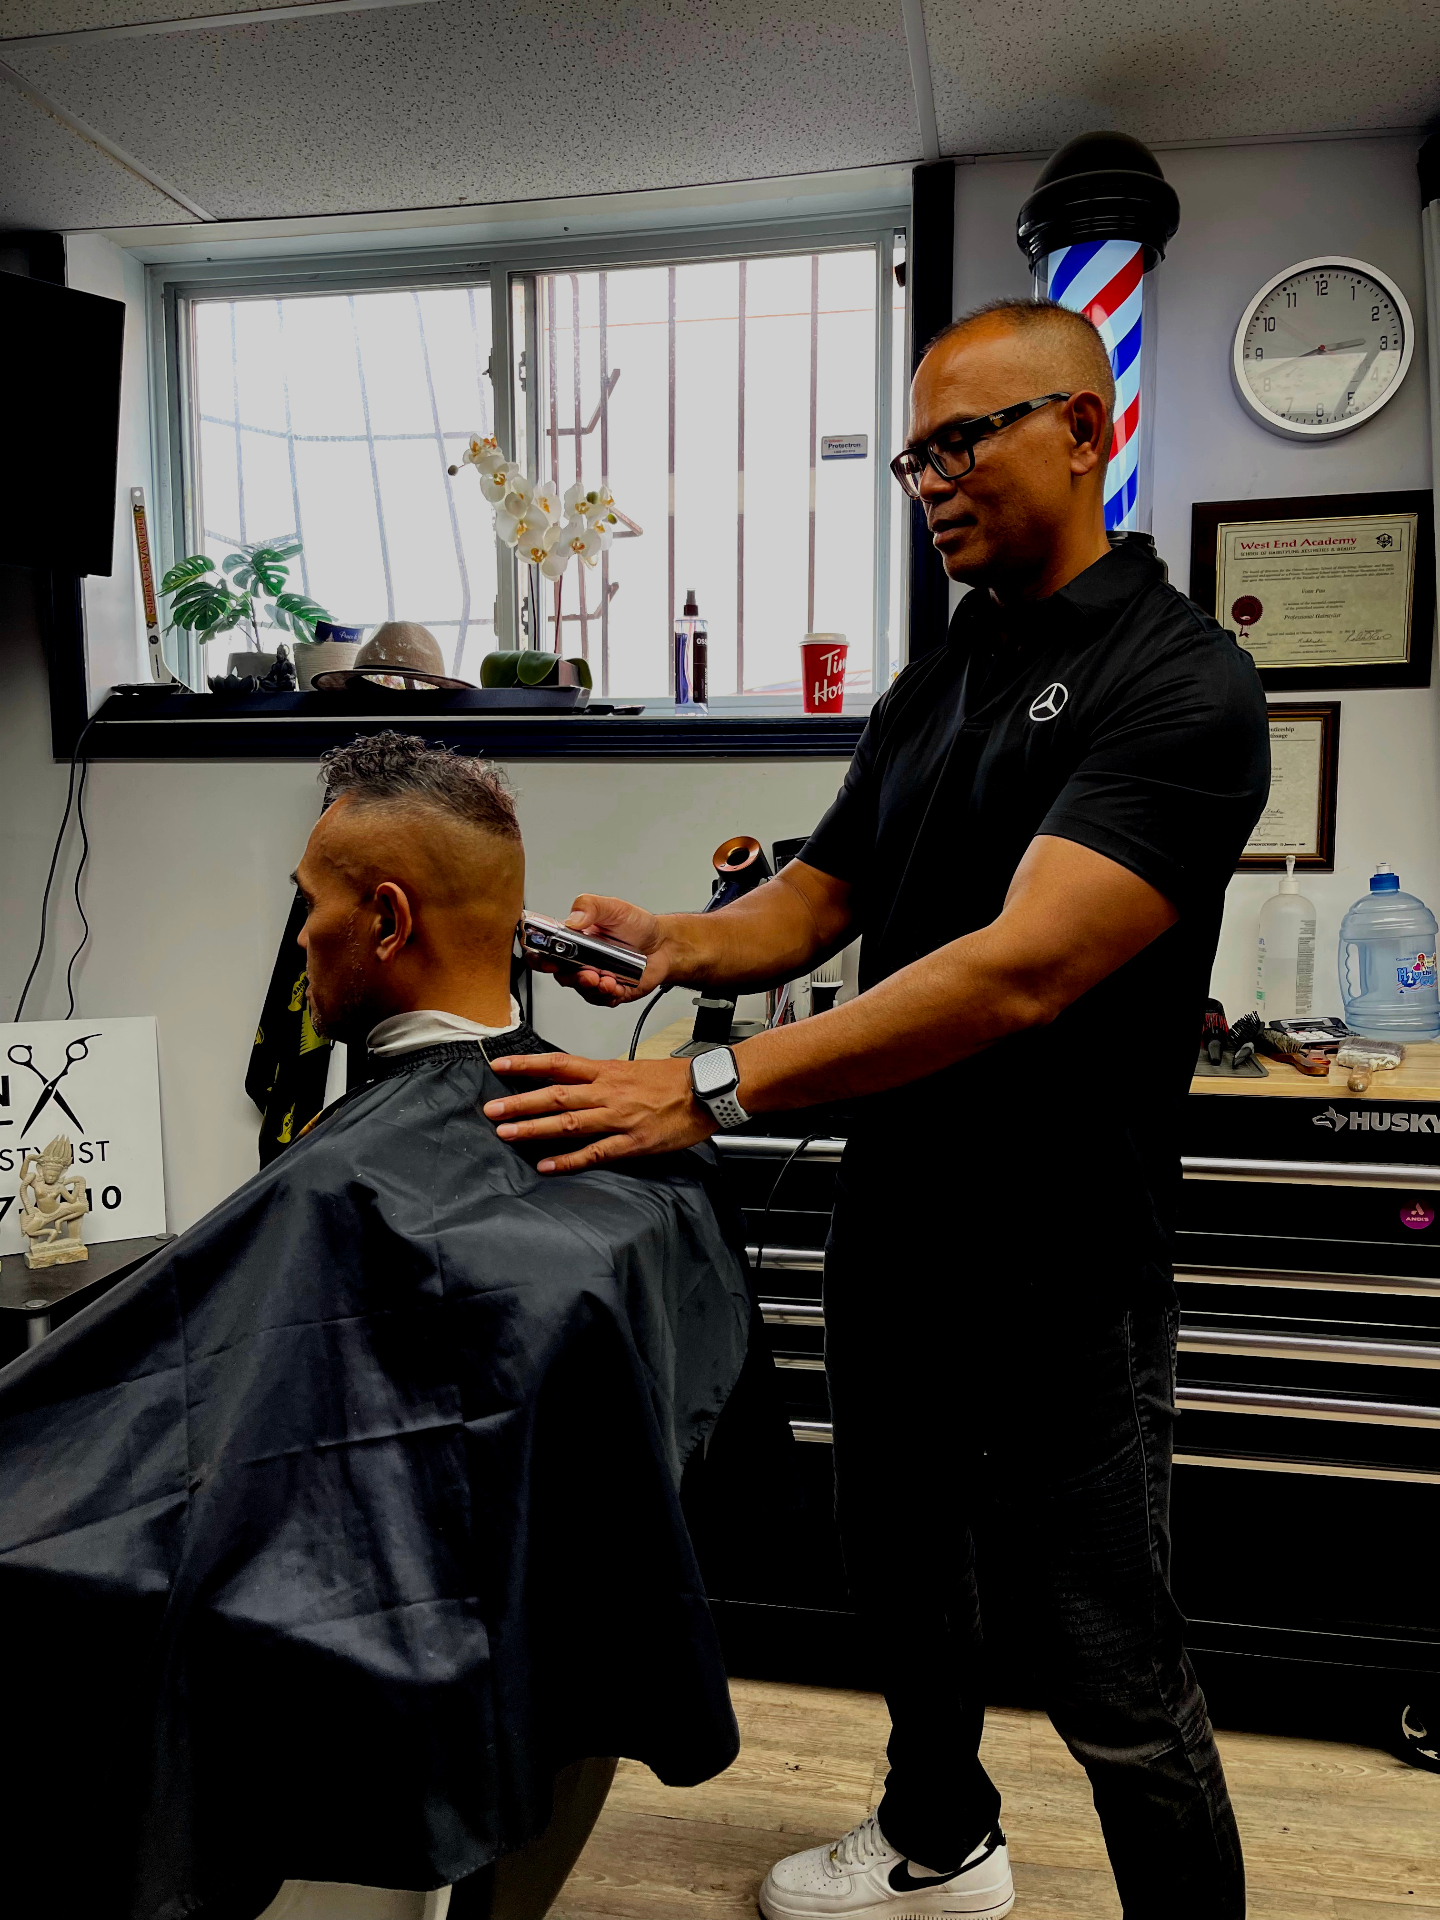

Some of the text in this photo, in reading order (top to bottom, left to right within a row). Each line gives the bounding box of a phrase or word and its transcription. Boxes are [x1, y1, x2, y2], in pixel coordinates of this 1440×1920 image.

[1316, 280, 1328, 296] 12
[1351, 286, 1355, 301] 1
[1286, 293, 1297, 308] 11
[1371, 306, 1380, 322] 2
[1263, 316, 1276, 332] 10
[1380, 336, 1388, 351] 3
[1255, 347, 1263, 362] 9
[1371, 367, 1379, 382] 4
[1263, 377, 1271, 392] 8
[1286, 397, 1293, 413] 7
[1347, 391, 1355, 407] 5
[1316, 402, 1324, 417] 6
[136, 518, 150, 561] OTTAWA
[1240, 536, 1358, 550] West End Academy
